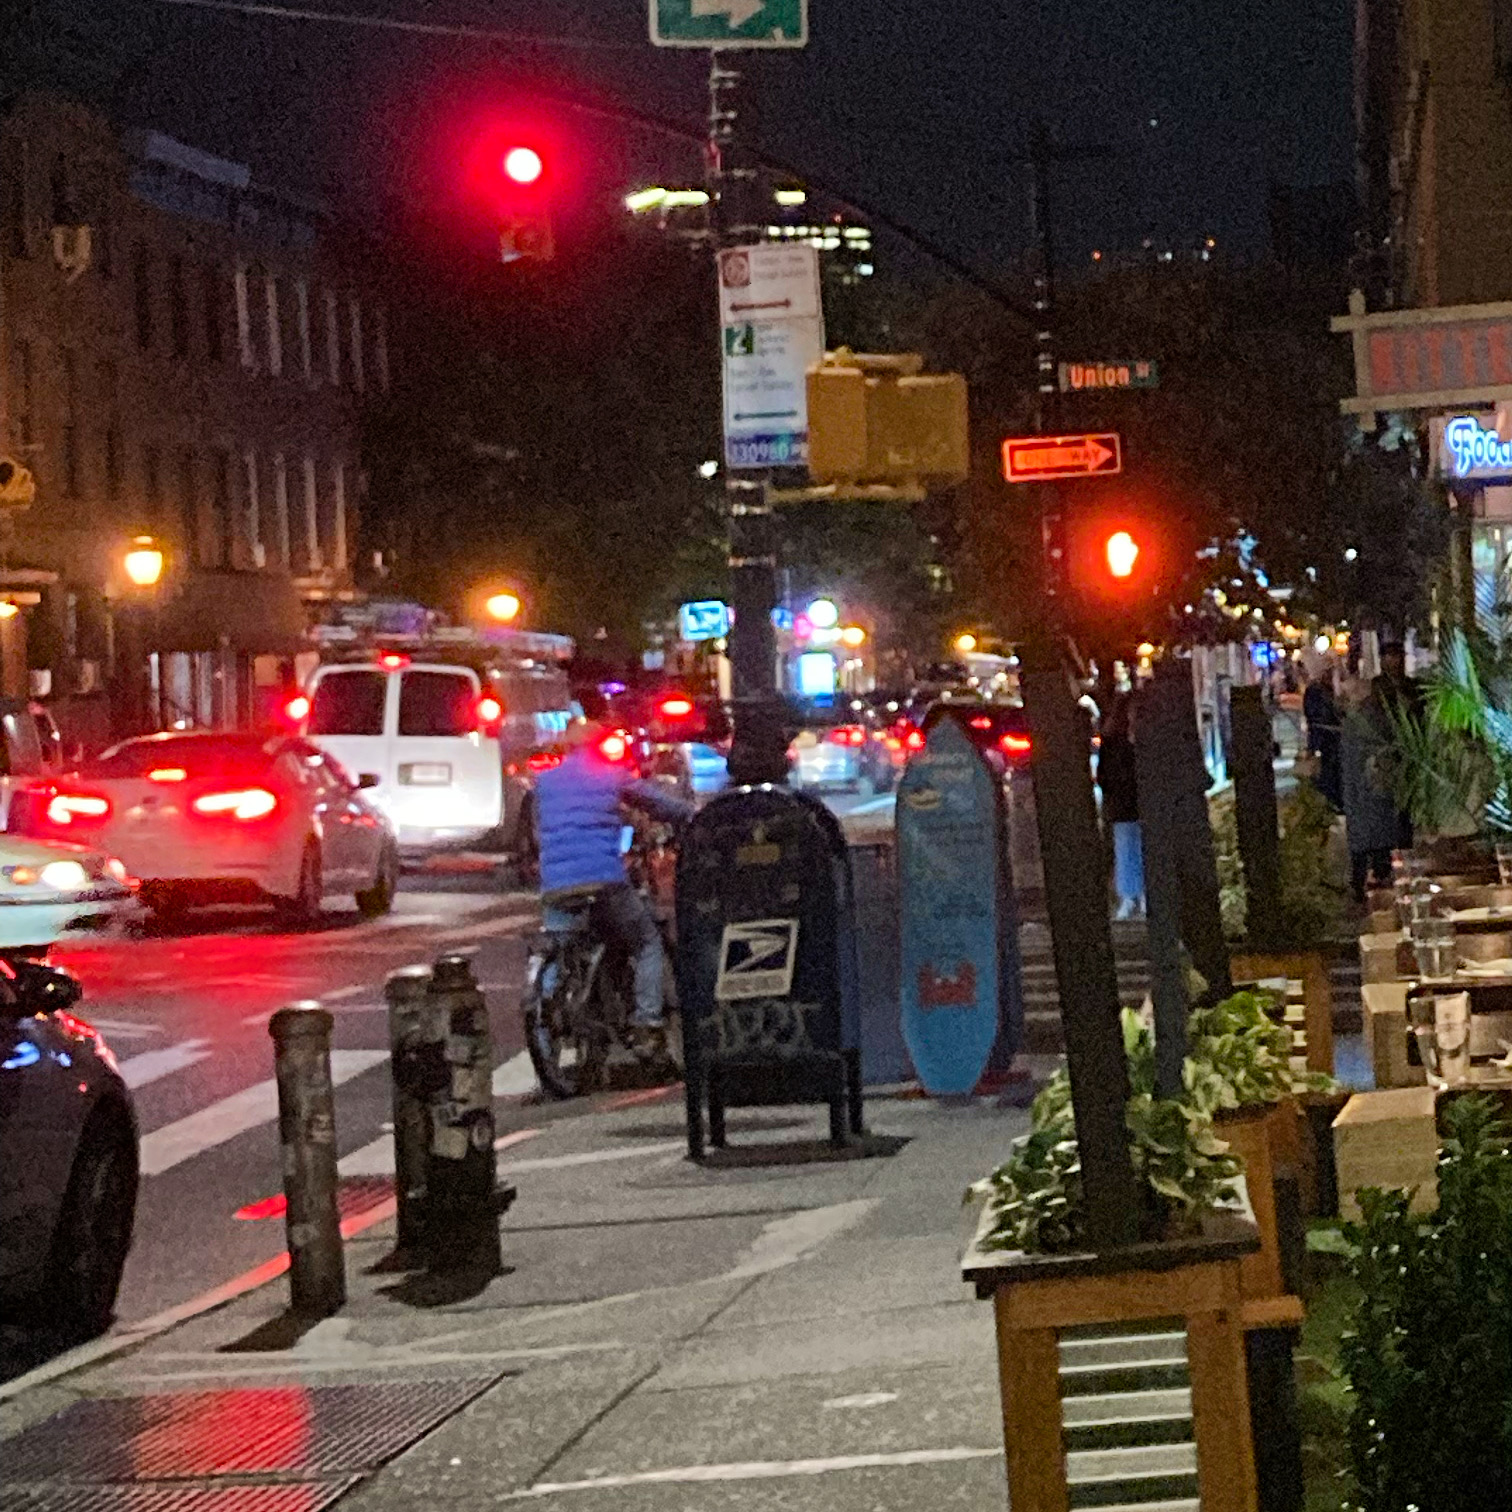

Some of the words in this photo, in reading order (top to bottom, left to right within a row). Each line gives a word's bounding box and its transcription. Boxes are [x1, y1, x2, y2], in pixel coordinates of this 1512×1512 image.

[1070, 363, 1131, 388] Union
[1024, 452, 1055, 466] ONE
[1069, 448, 1101, 462] WAY
